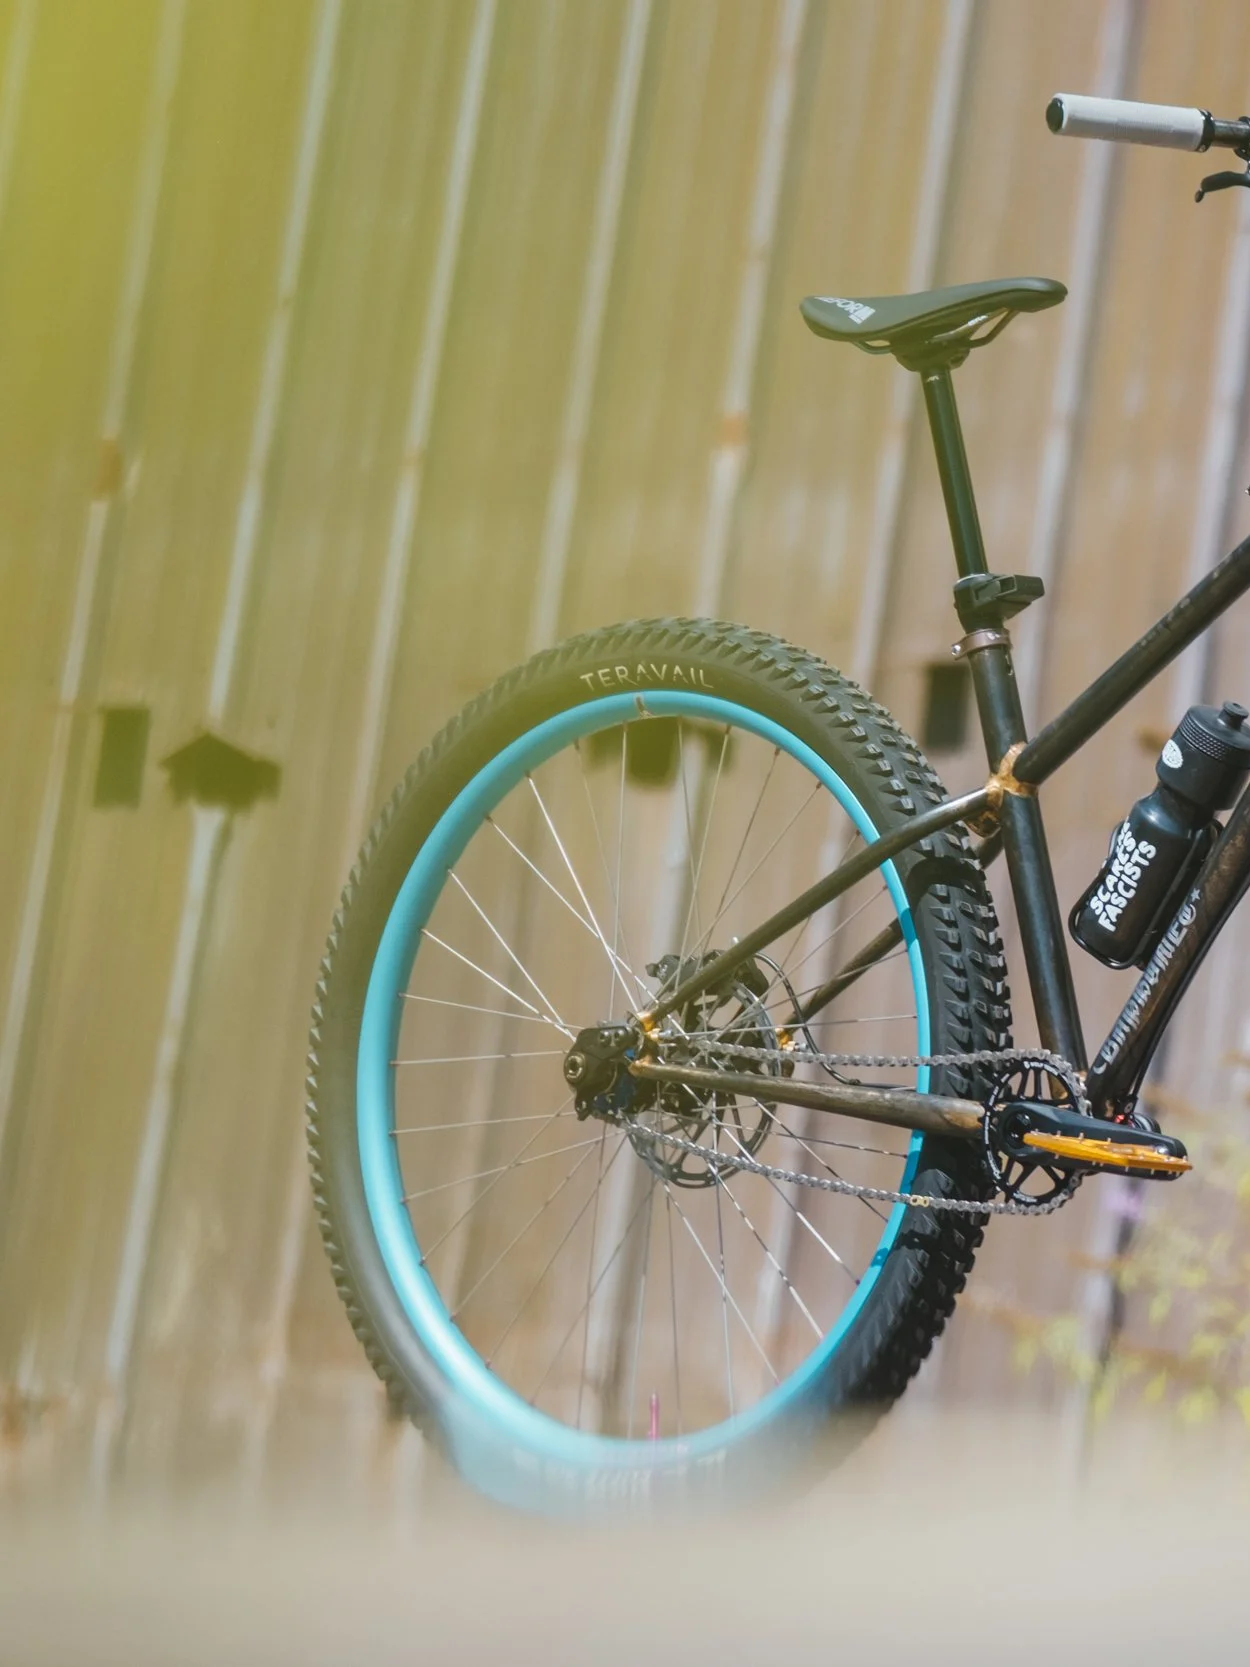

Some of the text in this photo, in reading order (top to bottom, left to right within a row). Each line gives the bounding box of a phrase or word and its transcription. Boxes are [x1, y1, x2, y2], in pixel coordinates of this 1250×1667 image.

[580, 663, 714, 691] TERAVAIL
[1089, 830, 1137, 915] SCARES
[1098, 840, 1157, 932] FASCISTS
